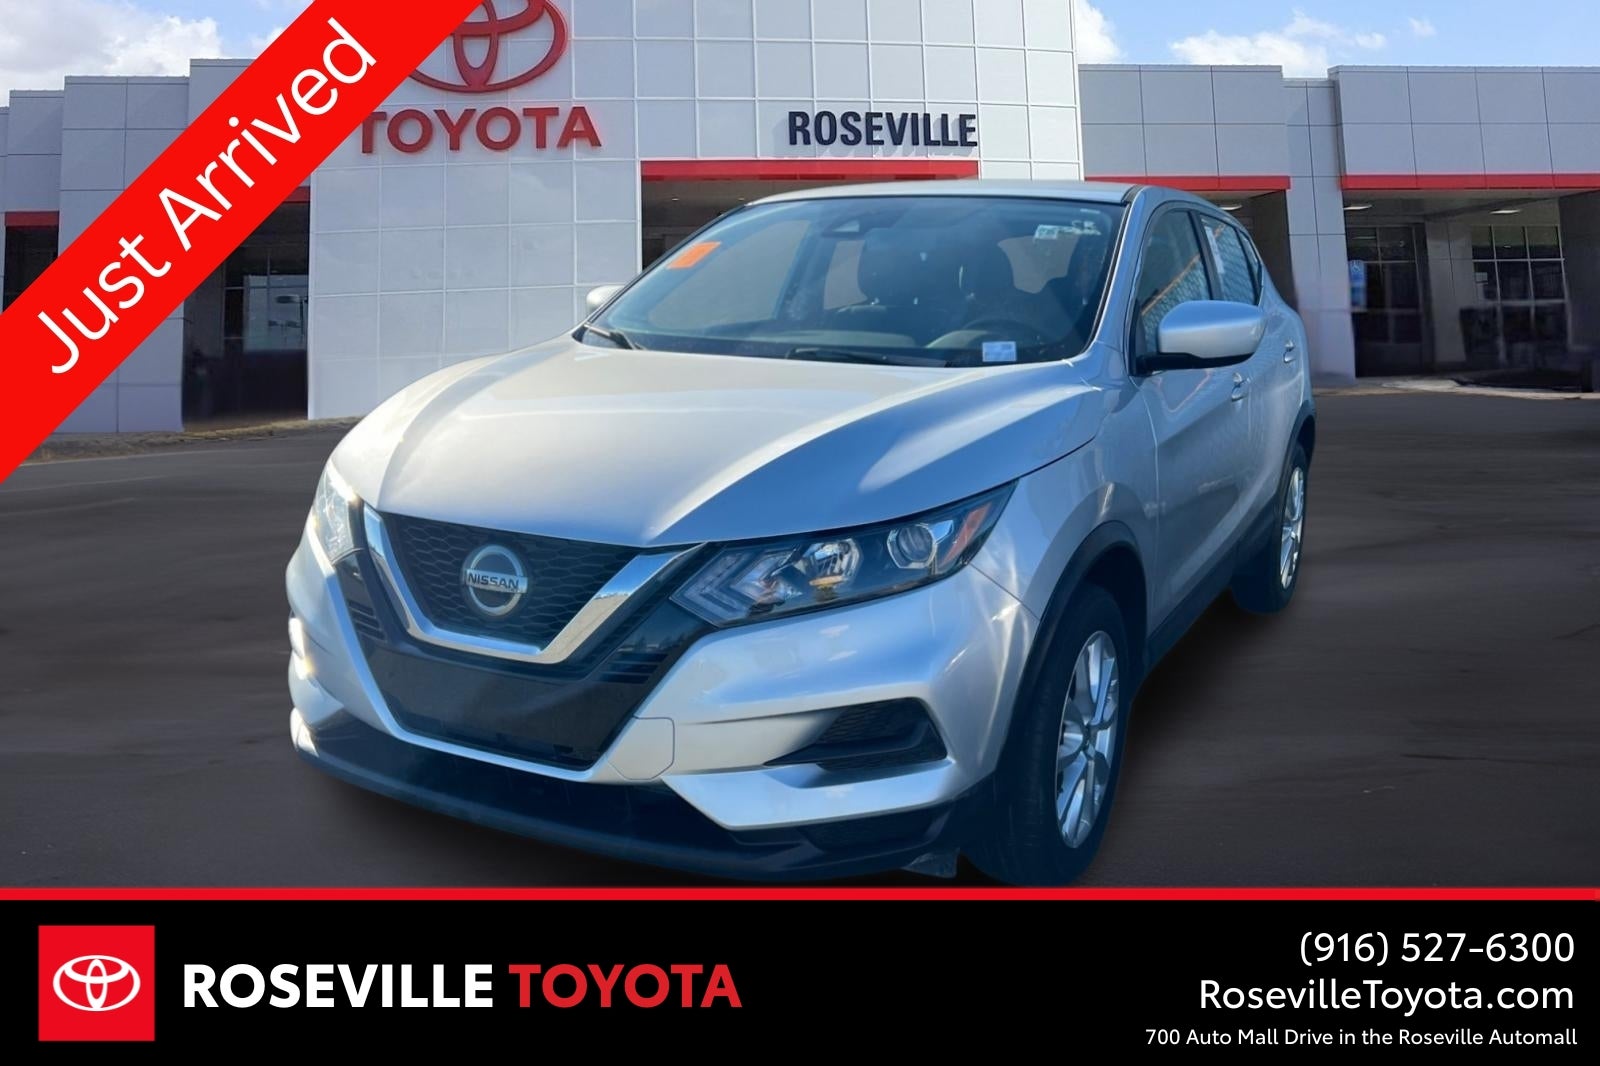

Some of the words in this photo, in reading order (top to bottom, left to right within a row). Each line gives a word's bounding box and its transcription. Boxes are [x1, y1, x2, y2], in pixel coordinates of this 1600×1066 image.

[361, 106, 602, 154] TOYOTA
[788, 110, 978, 147] ROSEVILLE
[467, 572, 519, 590] NISSAN
